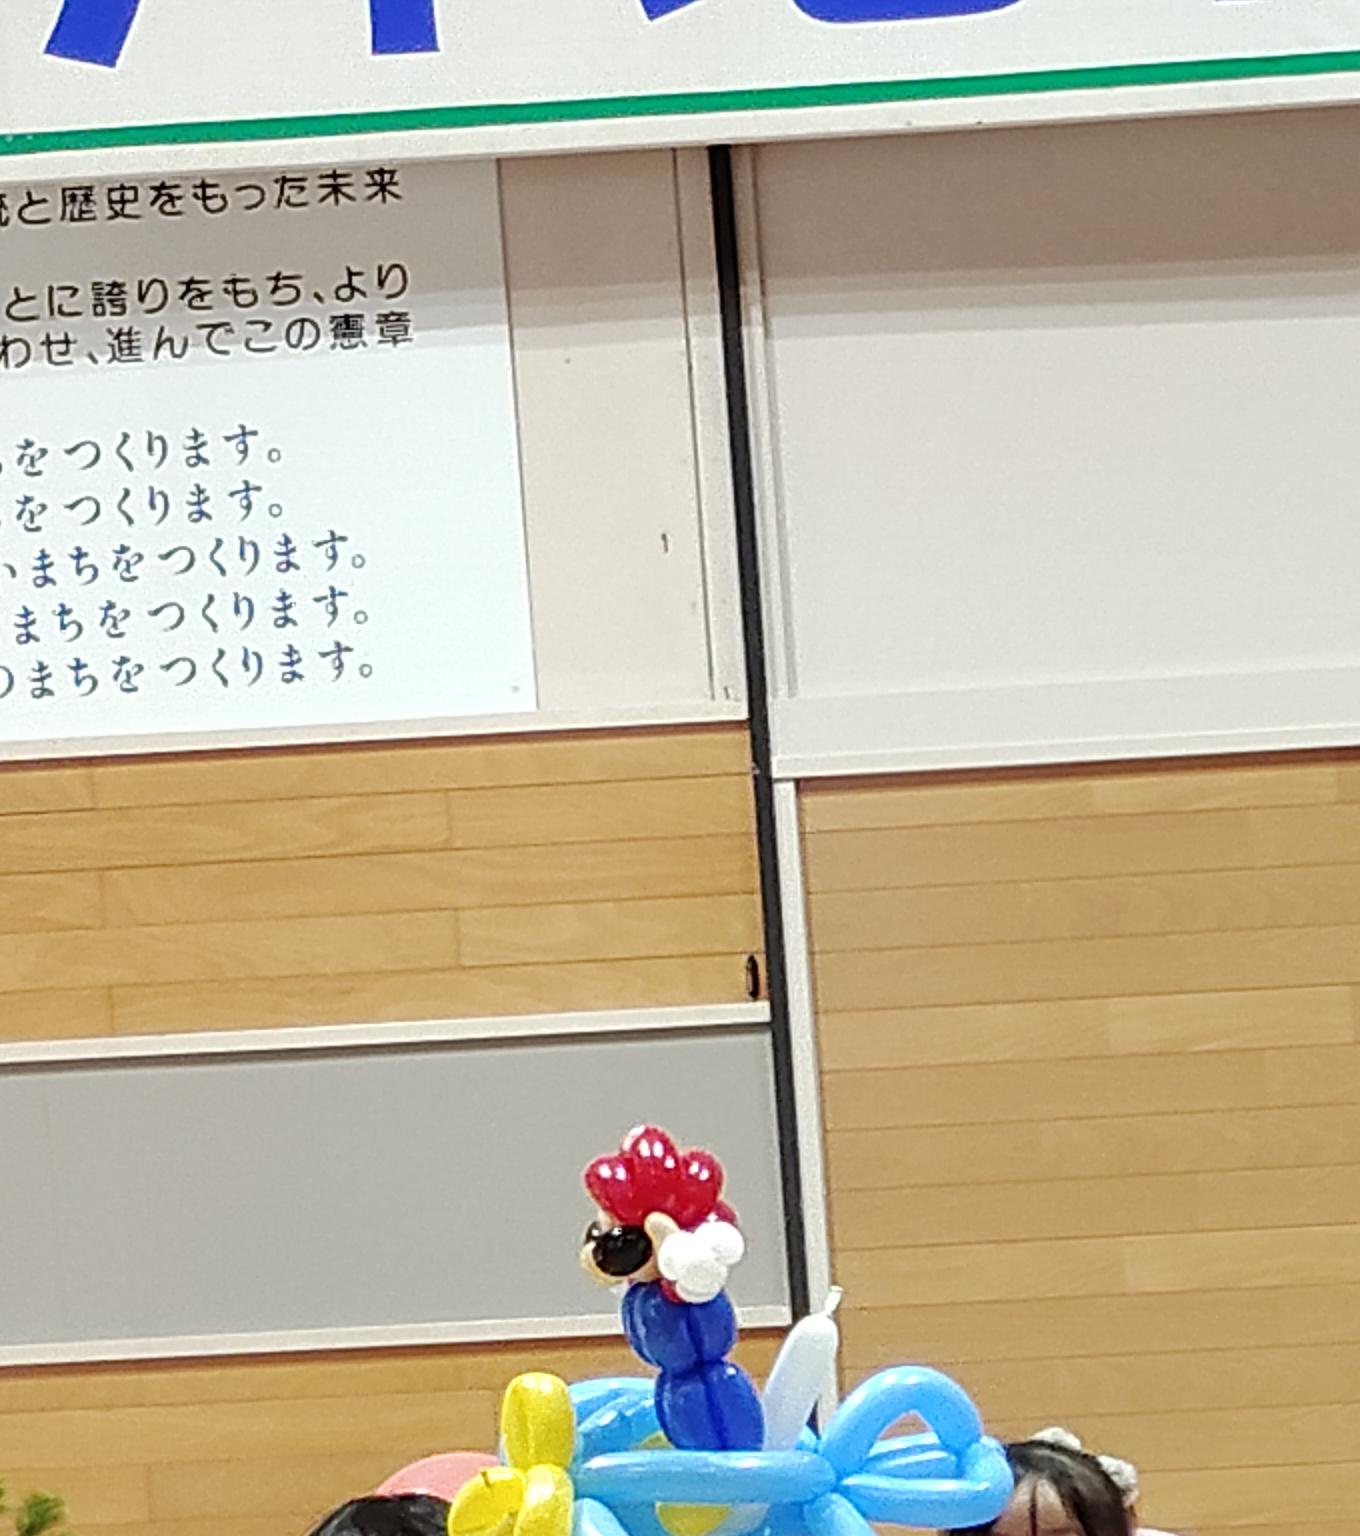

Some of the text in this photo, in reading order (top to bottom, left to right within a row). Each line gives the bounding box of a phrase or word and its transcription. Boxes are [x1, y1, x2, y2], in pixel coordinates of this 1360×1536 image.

[0, 166, 403, 228] と歴史をもった未来
[5, 264, 409, 322] とに誇りをもち、より
[0, 423, 282, 478] をつくります。
[13, 584, 369, 646] まちをつくります。
